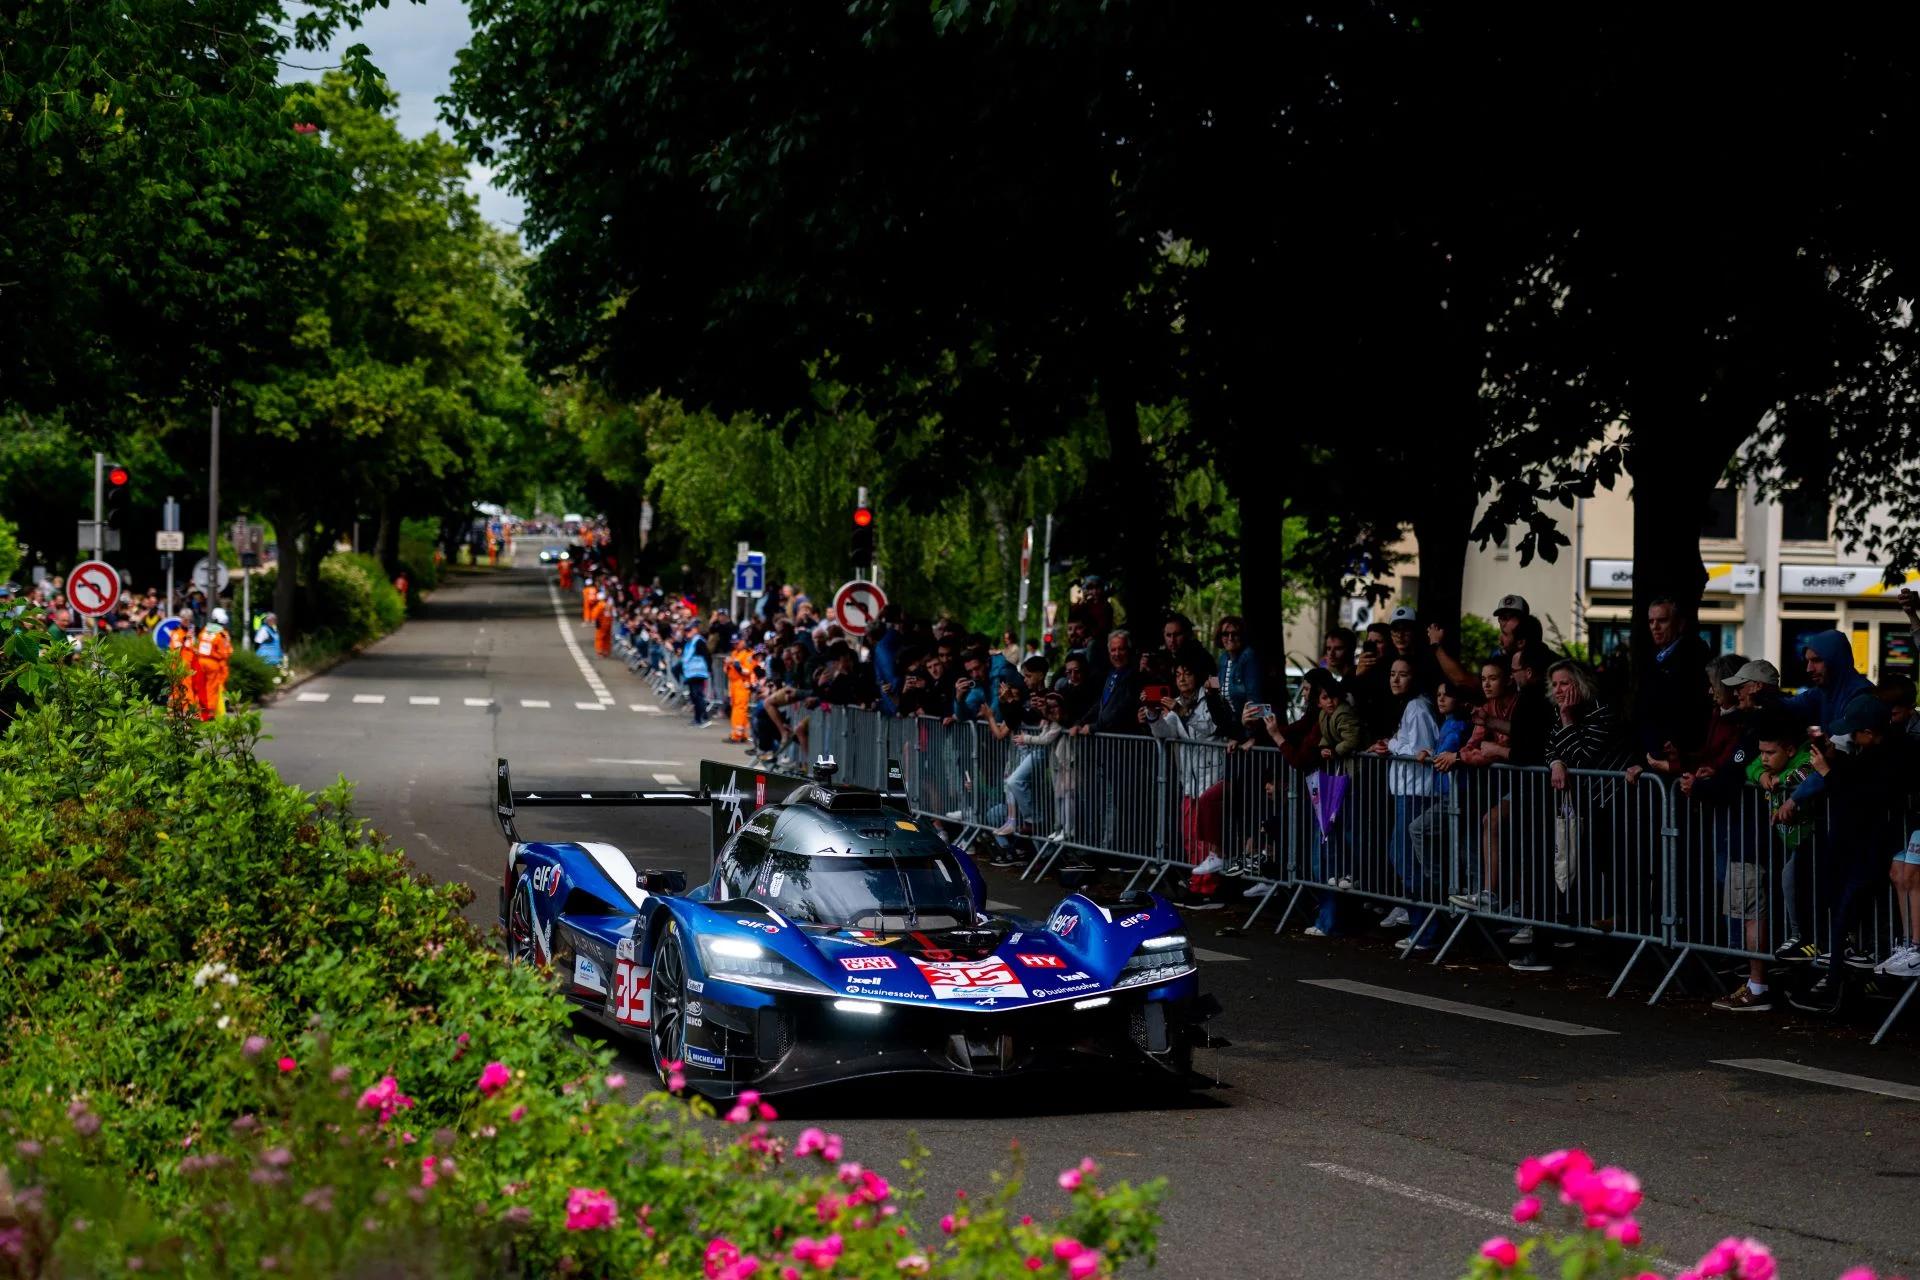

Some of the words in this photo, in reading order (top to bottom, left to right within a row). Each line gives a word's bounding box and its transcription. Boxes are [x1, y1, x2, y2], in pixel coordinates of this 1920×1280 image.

[809, 789, 832, 804] ALPINE
[533, 865, 552, 891] elf
[737, 919, 766, 929] elf
[1120, 917, 1138, 928] elf
[847, 961, 894, 970] CAR
[1019, 955, 1057, 966] HY
[923, 962, 1014, 985] 35
[616, 962, 652, 1023] 35
[861, 986, 930, 1000] businessolver
[1045, 982, 1101, 996] businessolver
[692, 1053, 723, 1065] MICHELIN
